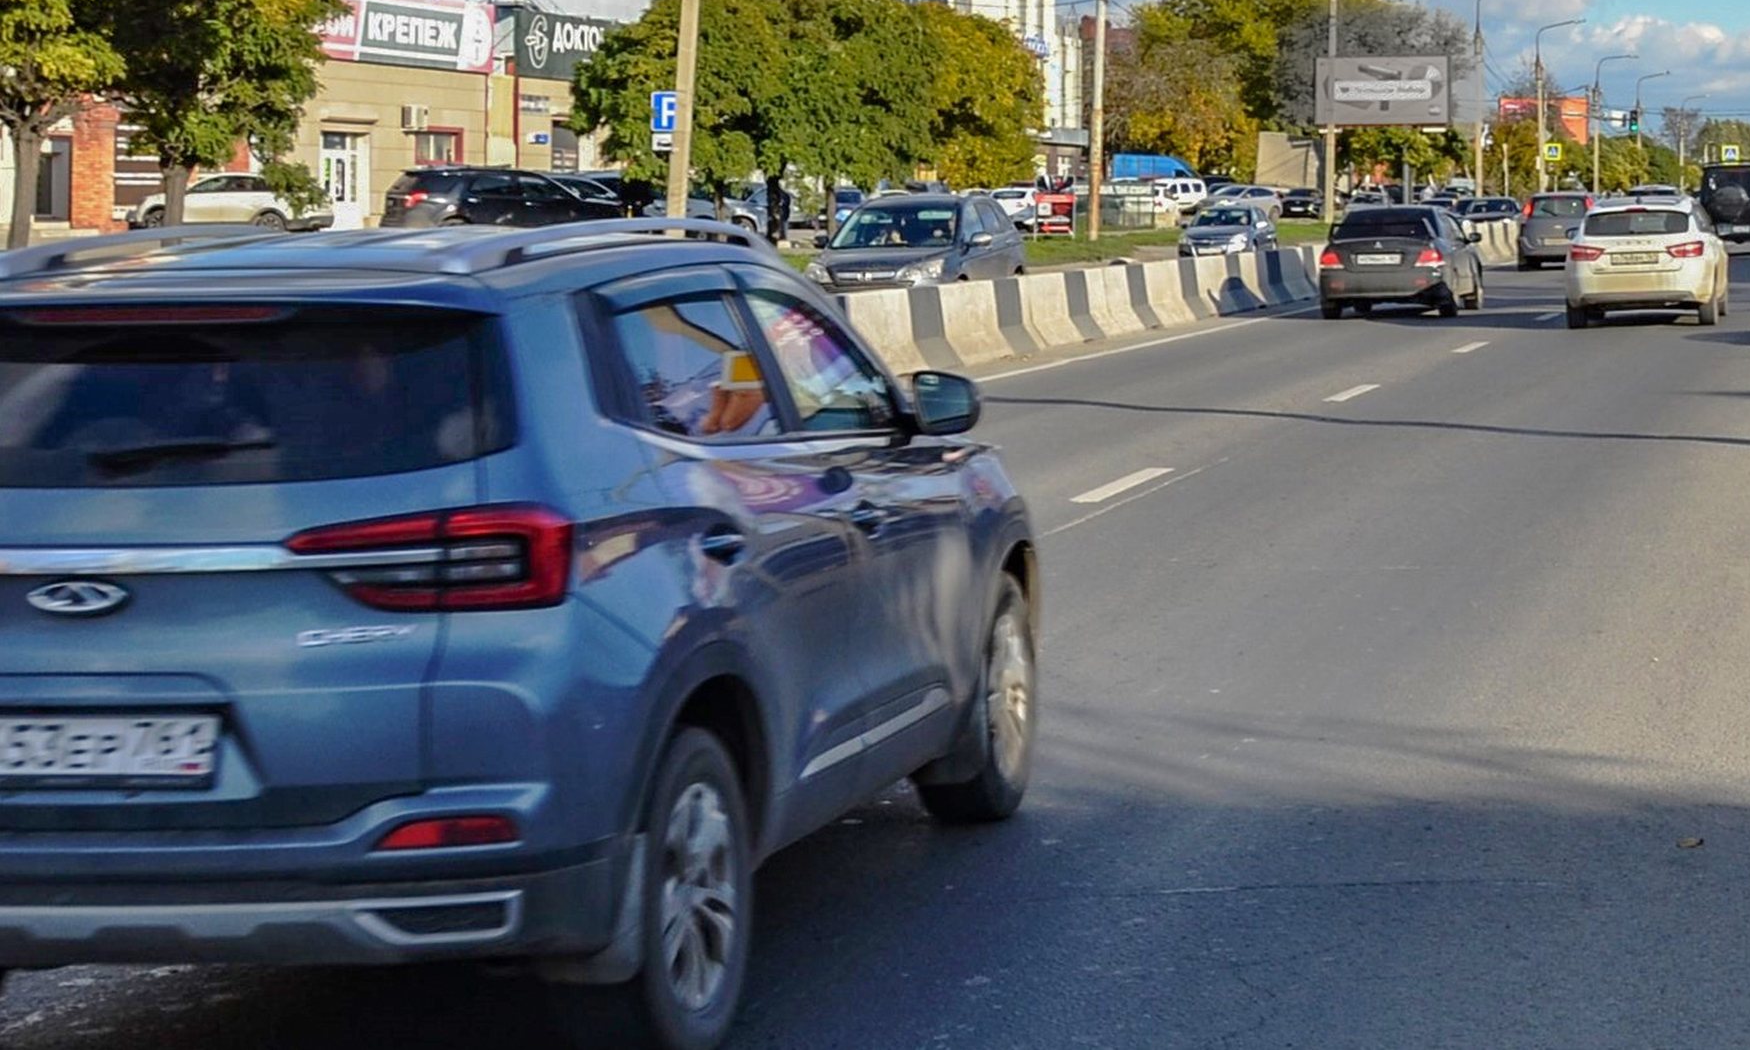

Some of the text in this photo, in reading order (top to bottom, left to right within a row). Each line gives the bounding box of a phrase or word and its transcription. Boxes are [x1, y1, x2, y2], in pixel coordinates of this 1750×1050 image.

[367, 11, 458, 49] КРЕПЕЖ
[552, 22, 605, 53] ДОКТО
[661, 97, 677, 127] P
